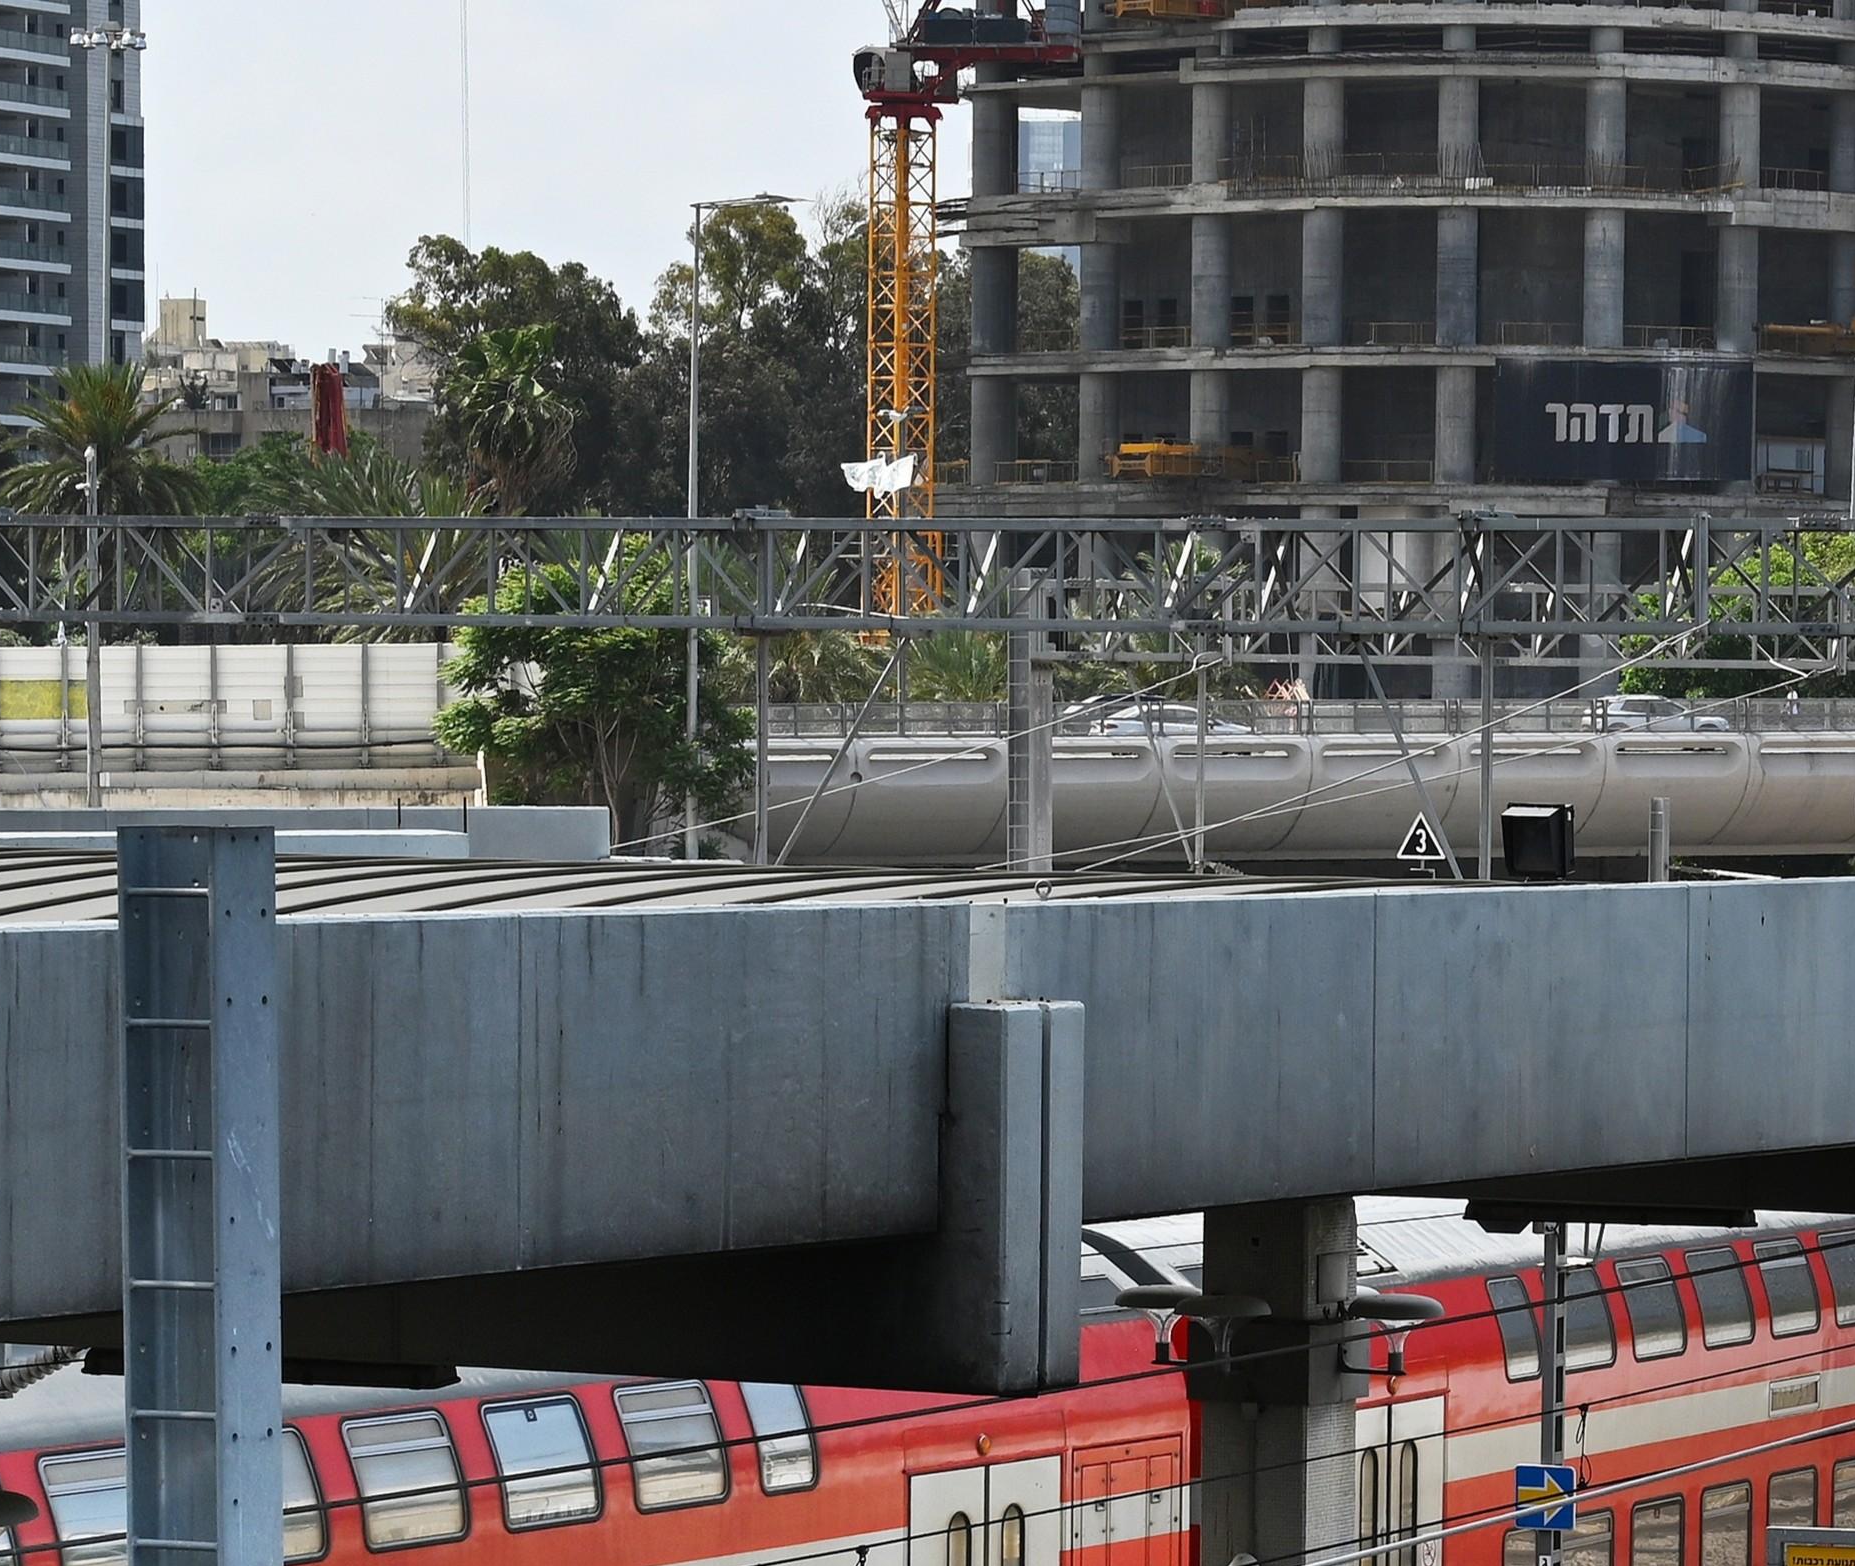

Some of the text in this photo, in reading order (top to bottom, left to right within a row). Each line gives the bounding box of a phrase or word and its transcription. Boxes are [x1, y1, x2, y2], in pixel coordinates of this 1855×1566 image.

[1545, 403, 1654, 443] תדהר
[1414, 828, 1428, 854] 3
[1826, 1559, 1855, 1566] תנועת
